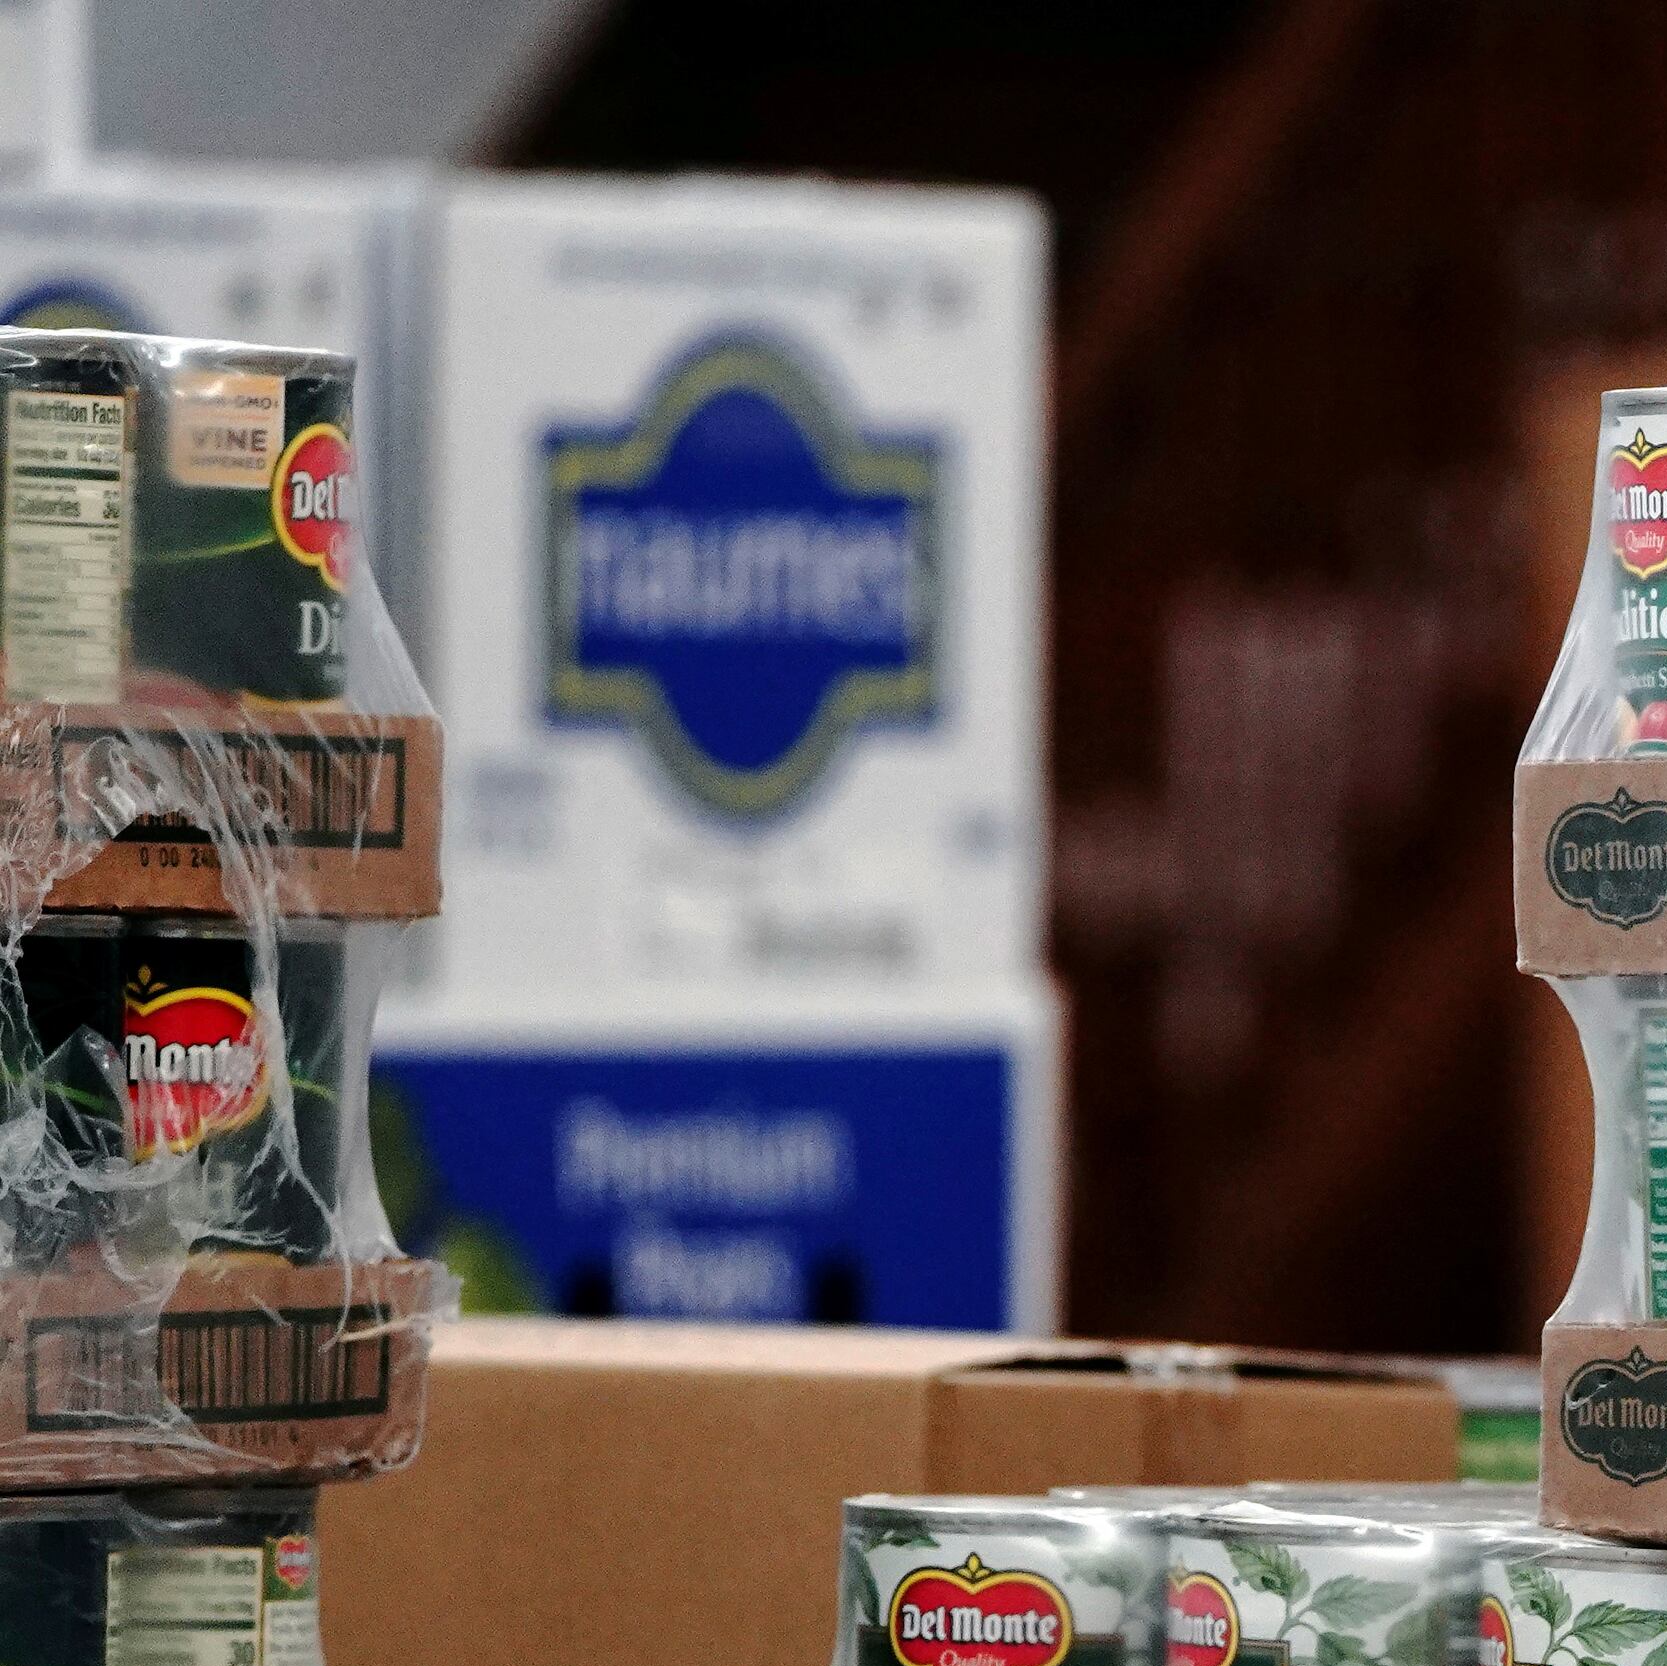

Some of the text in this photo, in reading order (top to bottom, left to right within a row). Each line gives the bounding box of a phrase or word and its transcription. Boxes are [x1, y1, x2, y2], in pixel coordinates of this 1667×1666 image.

[1623, 530, 1666, 554] Quality
[902, 1602, 1058, 1645] Del Monte
